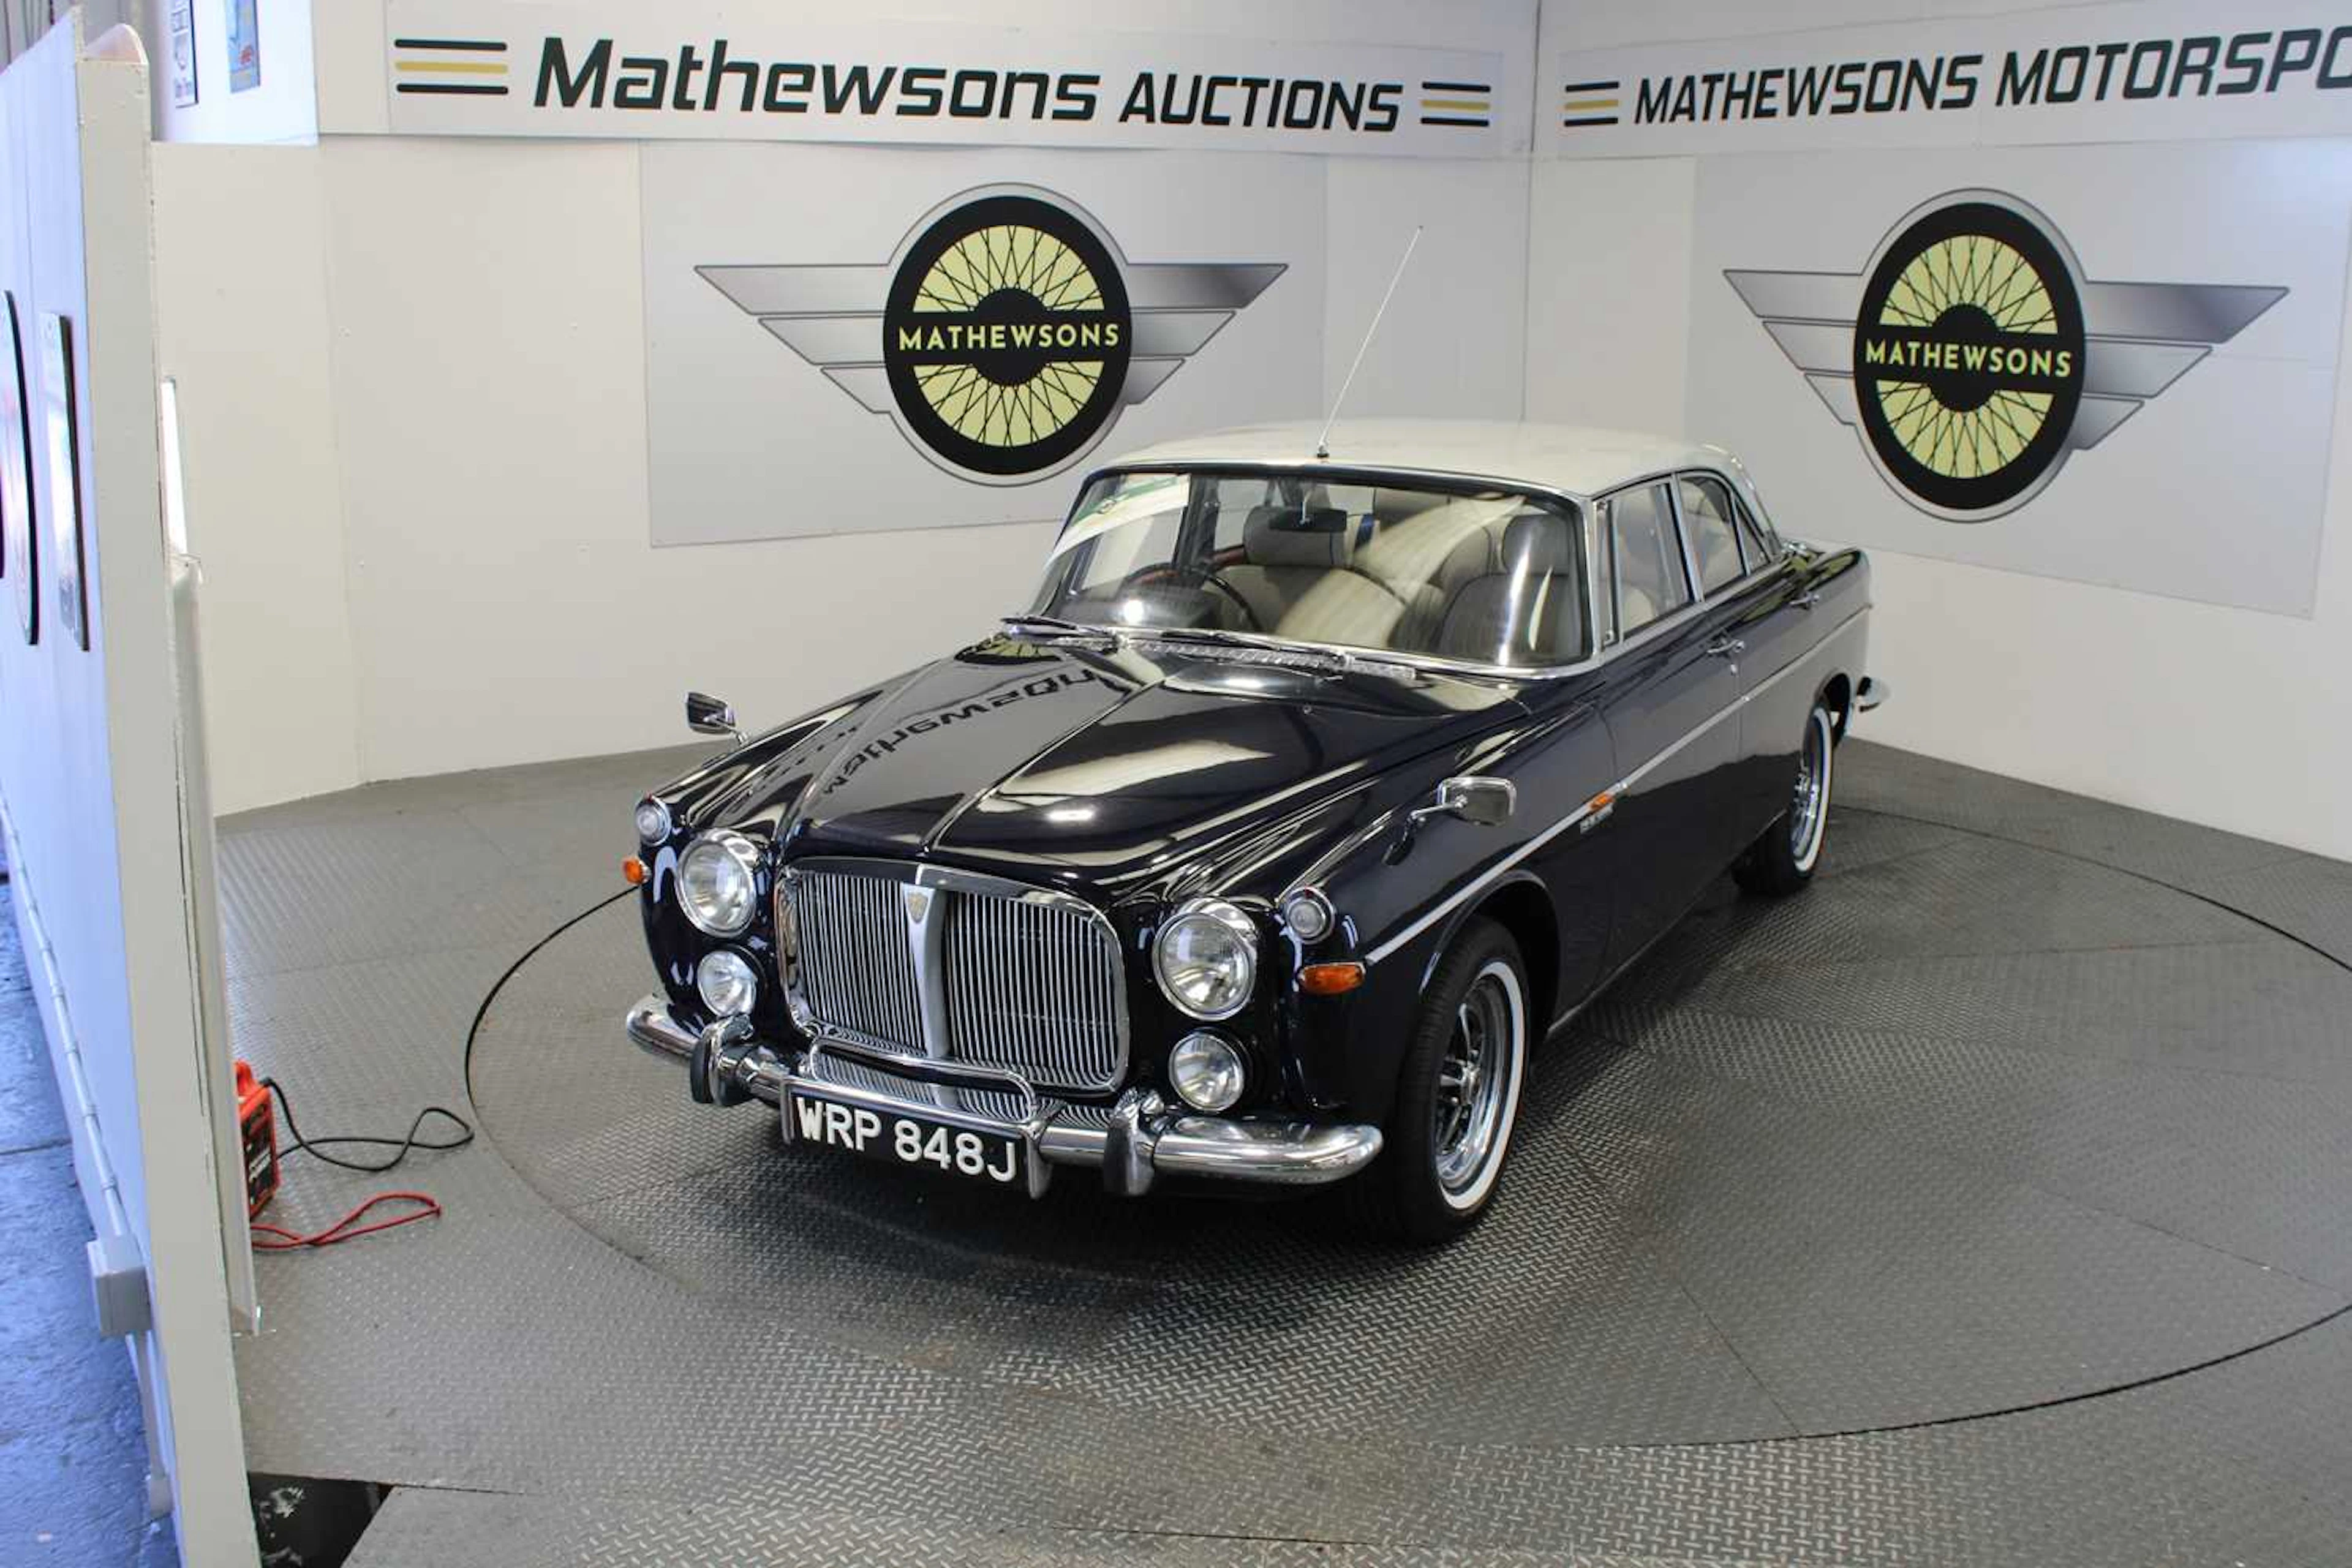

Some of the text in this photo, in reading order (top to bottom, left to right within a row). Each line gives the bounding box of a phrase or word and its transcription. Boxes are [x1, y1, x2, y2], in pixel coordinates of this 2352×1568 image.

[534, 37, 1404, 132] Mathewsons AUCTIONS
[1634, 55, 1983, 124] MATHEWSONS
[899, 323, 1119, 350] MATHEWSONS
[1866, 338, 2071, 377] MATHEWSONS
[797, 1097, 1017, 1182] WRP 848J
